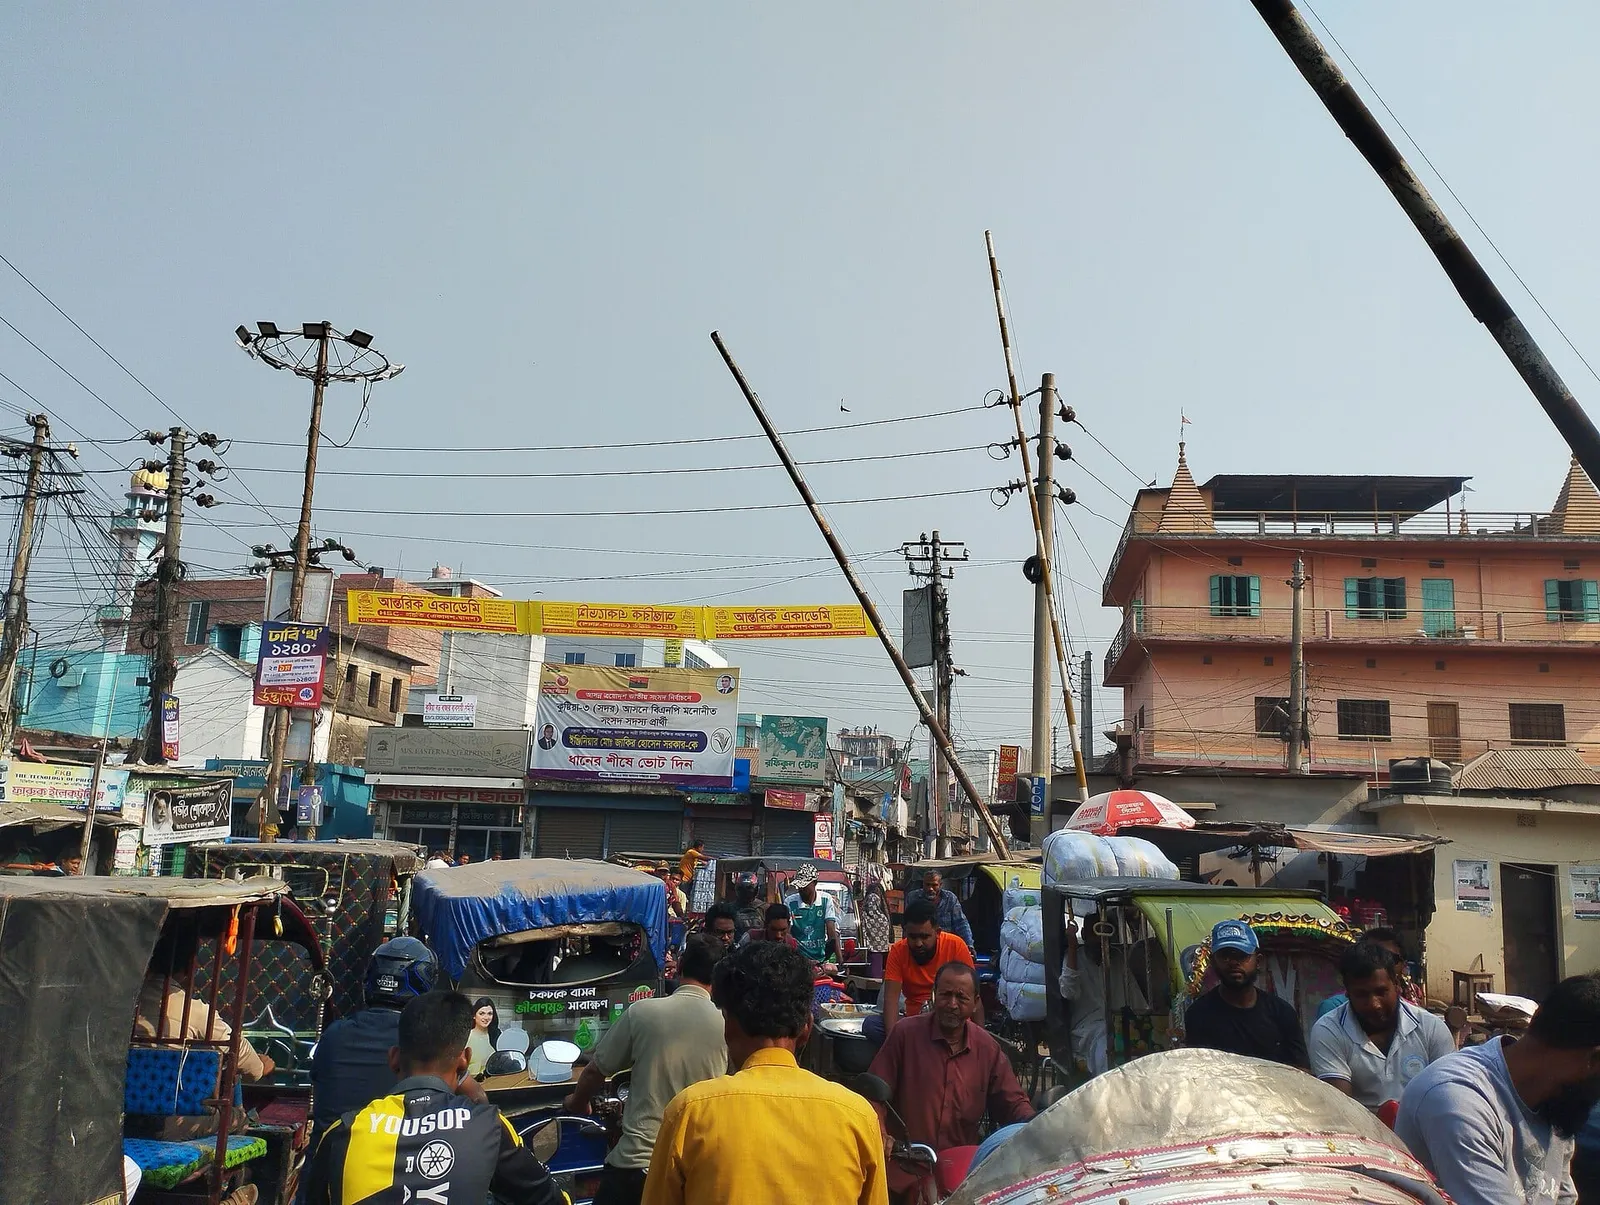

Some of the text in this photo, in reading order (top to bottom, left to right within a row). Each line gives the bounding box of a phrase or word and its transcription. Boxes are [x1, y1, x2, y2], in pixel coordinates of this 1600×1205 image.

[377, 595, 481, 613] আন্তরিক একাডেমি
[733, 608, 776, 623] আন্তরিক
[781, 606, 831, 622] একাডেমি
[268, 626, 300, 642] ঢাবি
[556, 702, 717, 716] কুষ্টিয়া-৩ (সদর) আসনে বিএনপি মনোনীত
[600, 715, 668, 727] সংসদ সদস্য প্রার্থী
[614, 735, 636, 747] জাকির
[638, 739, 662, 748] হোসেন
[568, 753, 694, 770] ধানের শীষে ভোট দিন
[764, 757, 819, 771] রফিকুল স্টোর
[54, 769, 72, 777] FKB
[172, 799, 189, 818] গভীর
[529, 987, 597, 1000] চকচকে বাসন
[515, 999, 609, 1015] জীবাণুমুক্ত সারাক্ষণ
[369, 1107, 471, 1137] YOUSOP
